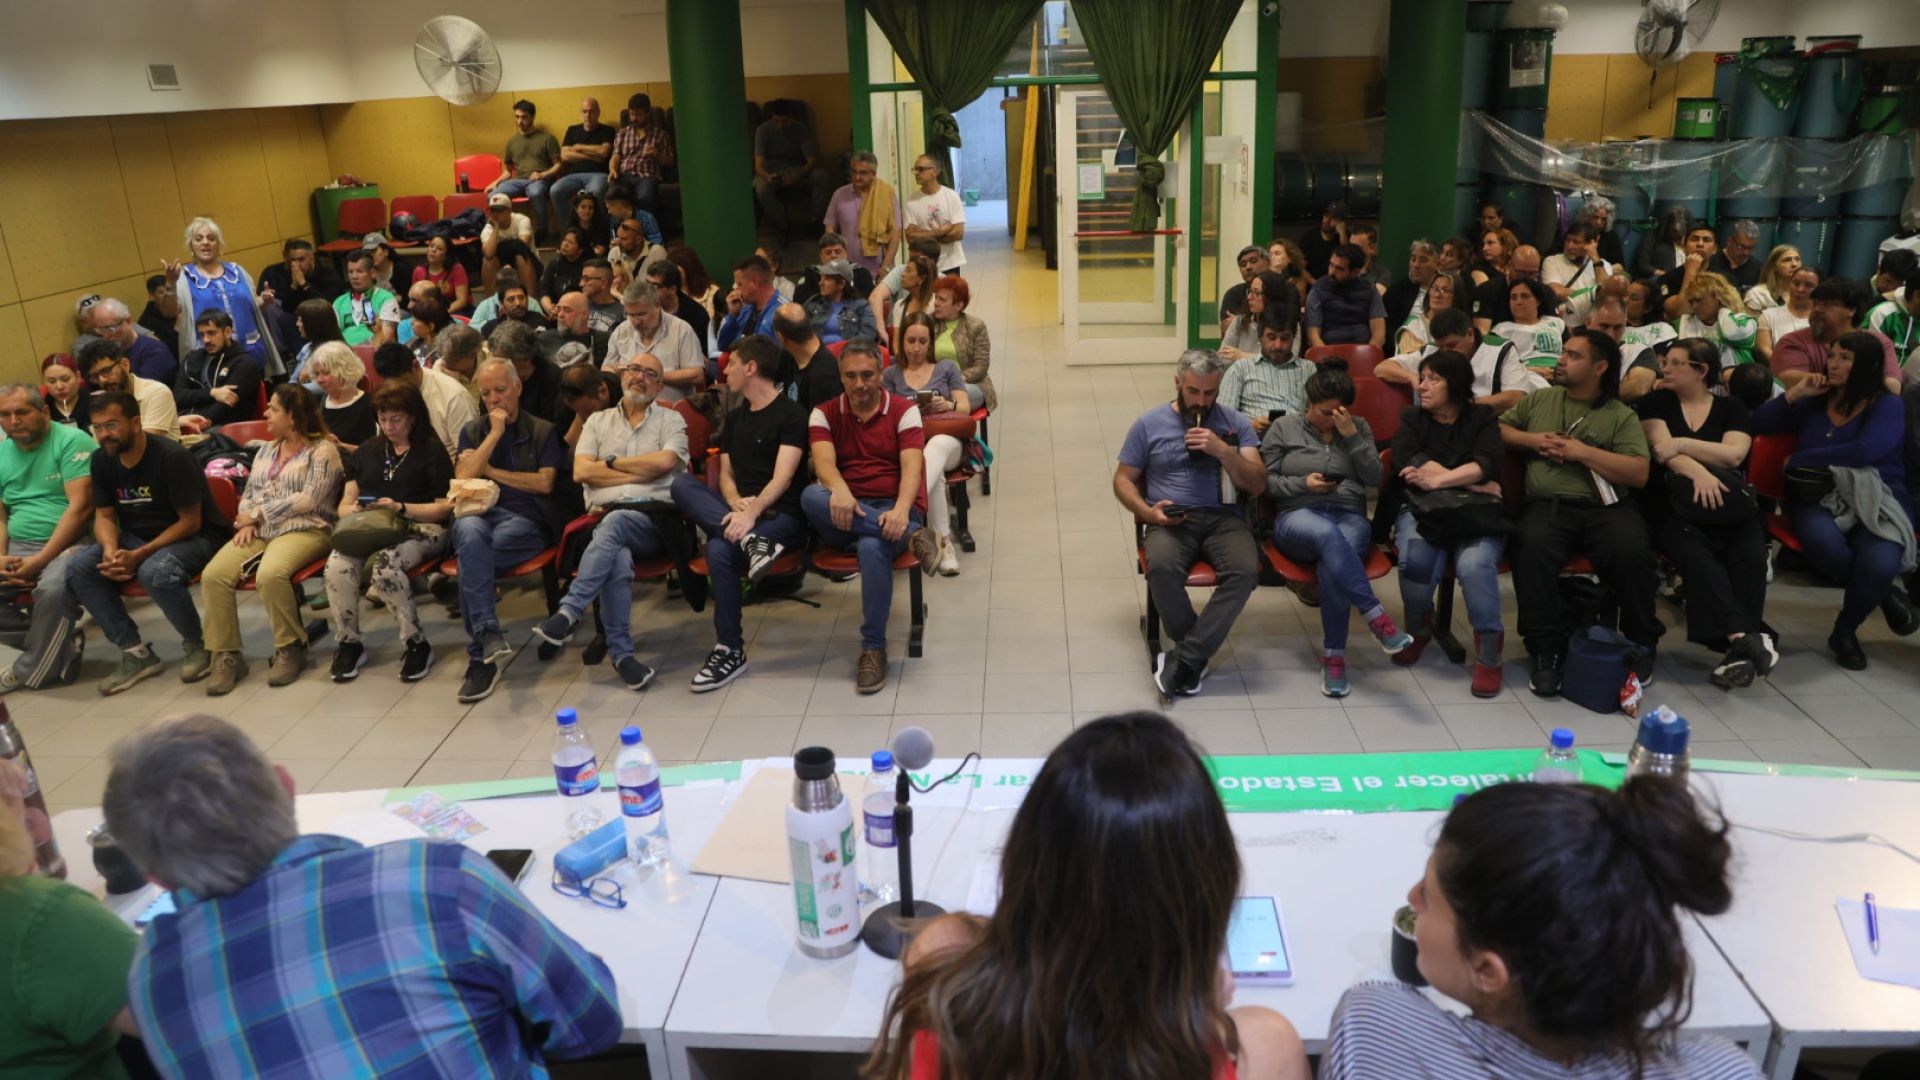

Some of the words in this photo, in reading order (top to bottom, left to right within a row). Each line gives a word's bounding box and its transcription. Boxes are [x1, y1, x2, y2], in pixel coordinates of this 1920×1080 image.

[992, 774, 1032, 787] ar
[1218, 776, 1343, 792] Estado
[1352, 775, 1383, 792] el
